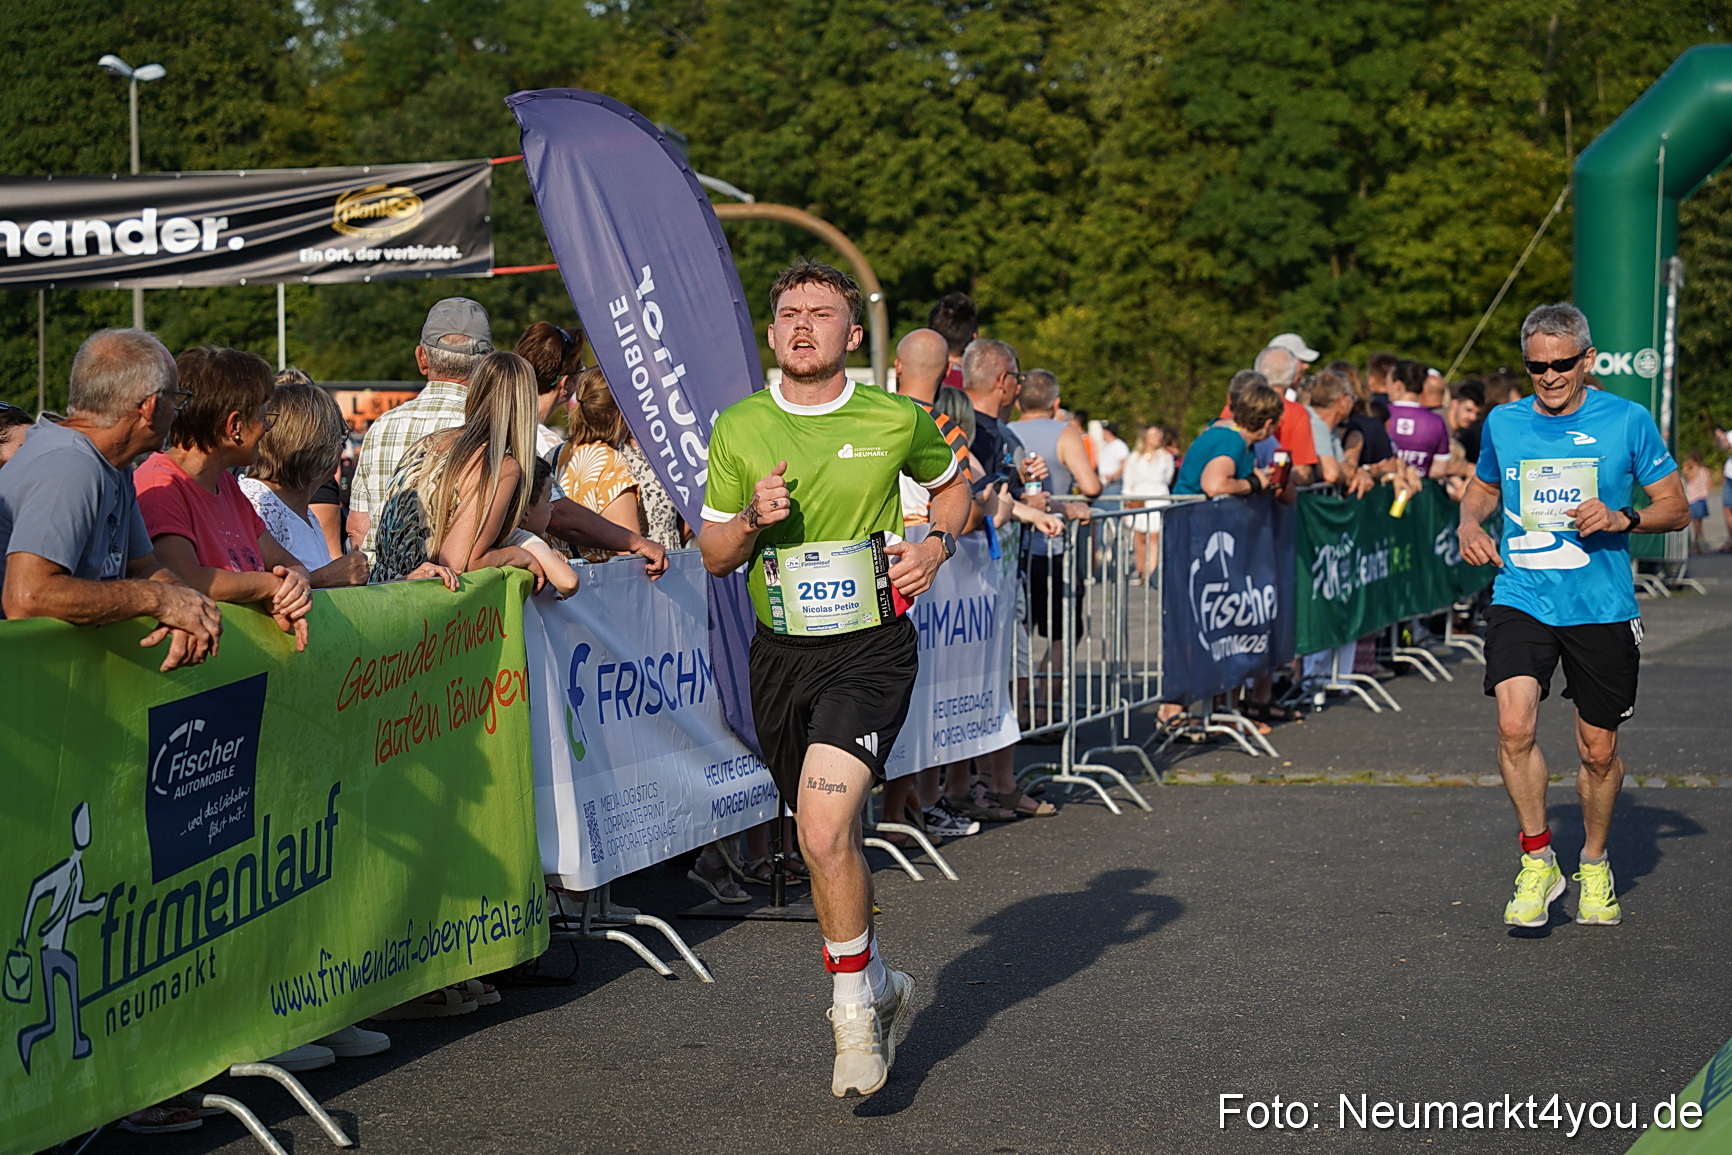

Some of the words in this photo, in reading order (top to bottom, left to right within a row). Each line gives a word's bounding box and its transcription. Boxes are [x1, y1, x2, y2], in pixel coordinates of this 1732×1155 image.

[299, 247, 323, 263] Ein
[324, 246, 354, 263] Ort,
[354, 245, 383, 262] der
[383, 244, 463, 261] verbindet.
[1589, 351, 1634, 376] OK
[853, 450, 889, 458] NEUMARKT
[1533, 488, 1582, 504] 4042
[797, 579, 856, 601] 2679
[880, 589, 889, 618] HILTL
[802, 605, 833, 613] Nicolas
[834, 602, 860, 612] Petito
[337, 618, 438, 712] Gesunde
[439, 605, 508, 665] Firmen
[374, 690, 442, 766] laufen
[446, 665, 527, 735] länger
[167, 736, 245, 785] Fischer
[703, 758, 736, 788] HEUTE
[173, 764, 236, 800] AUTOMOBILE
[620, 781, 659, 808] LOGISTICS
[806, 776, 817, 789] No
[818, 777, 848, 795] Regrets
[187, 808, 204, 832] und
[602, 806, 644, 836] CORPORATE
[643, 800, 666, 822] PRINT
[711, 791, 751, 823] MORGEN
[606, 826, 648, 858] CORPORATE
[647, 818, 677, 845] SIGNAGE
[100, 780, 341, 989] firmenlauf
[269, 881, 545, 1018] www.firmenlauf-oberpfalz.de
[105, 946, 217, 1037] neumarkt
